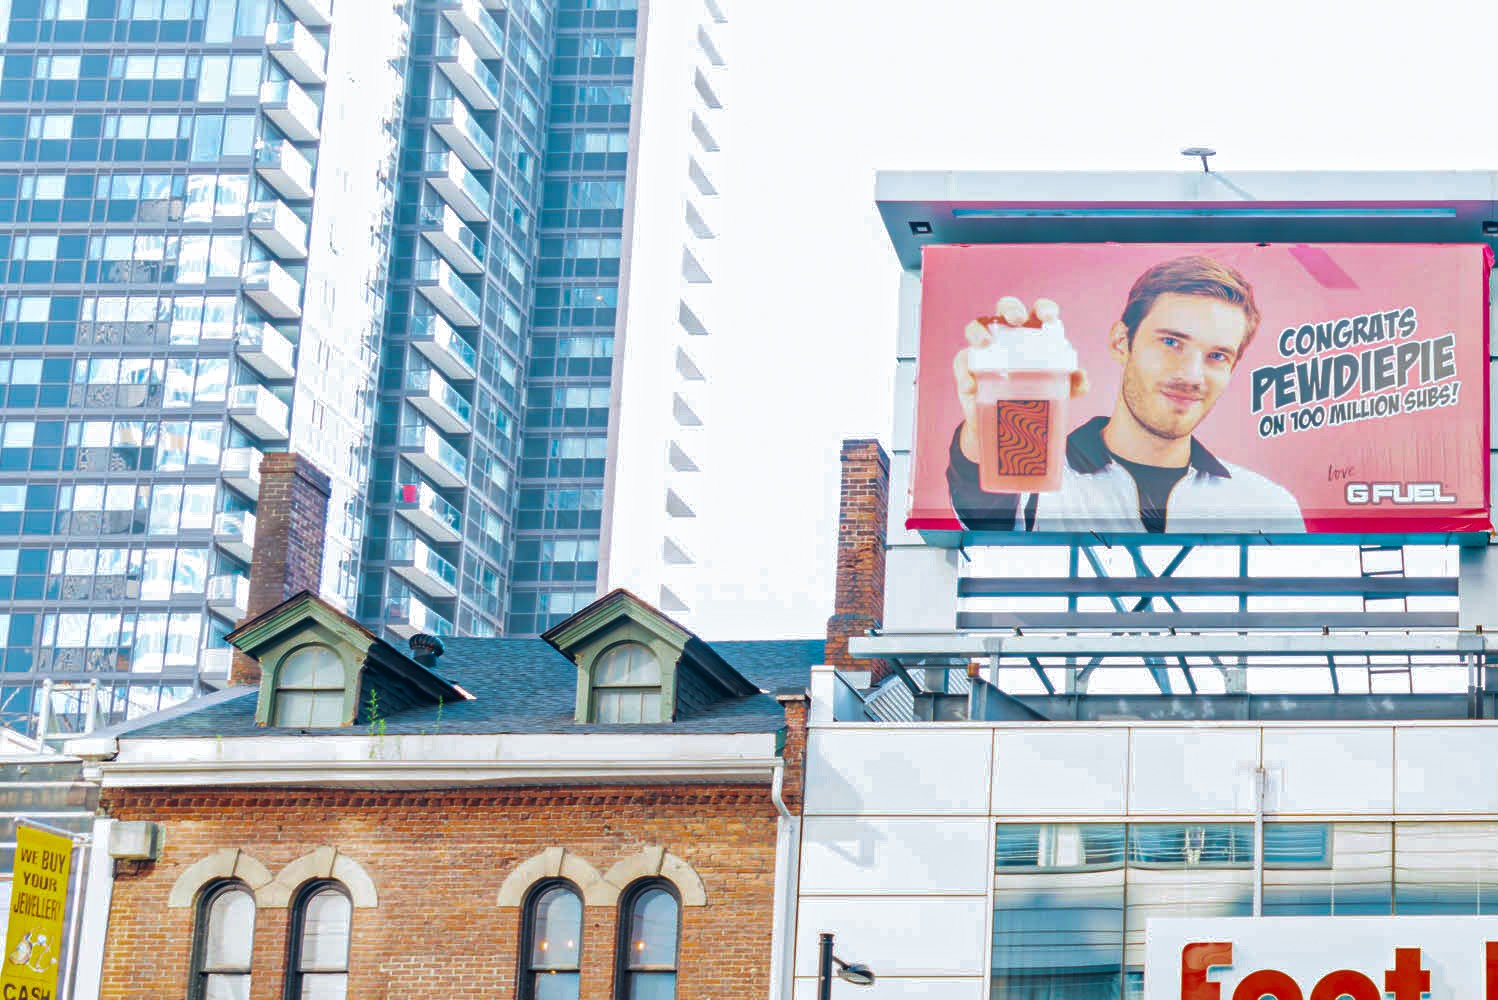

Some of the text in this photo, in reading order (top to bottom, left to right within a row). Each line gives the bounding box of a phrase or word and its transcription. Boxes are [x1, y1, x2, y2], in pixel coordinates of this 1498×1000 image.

[1279, 308, 1416, 356] CONGRATS
[1251, 335, 1456, 413] PEWDIEPIE
[1260, 383, 1460, 437] ON 100 MILLION SUBS!
[20, 847, 66, 874] WE BUY
[23, 872, 57, 892] YOUR
